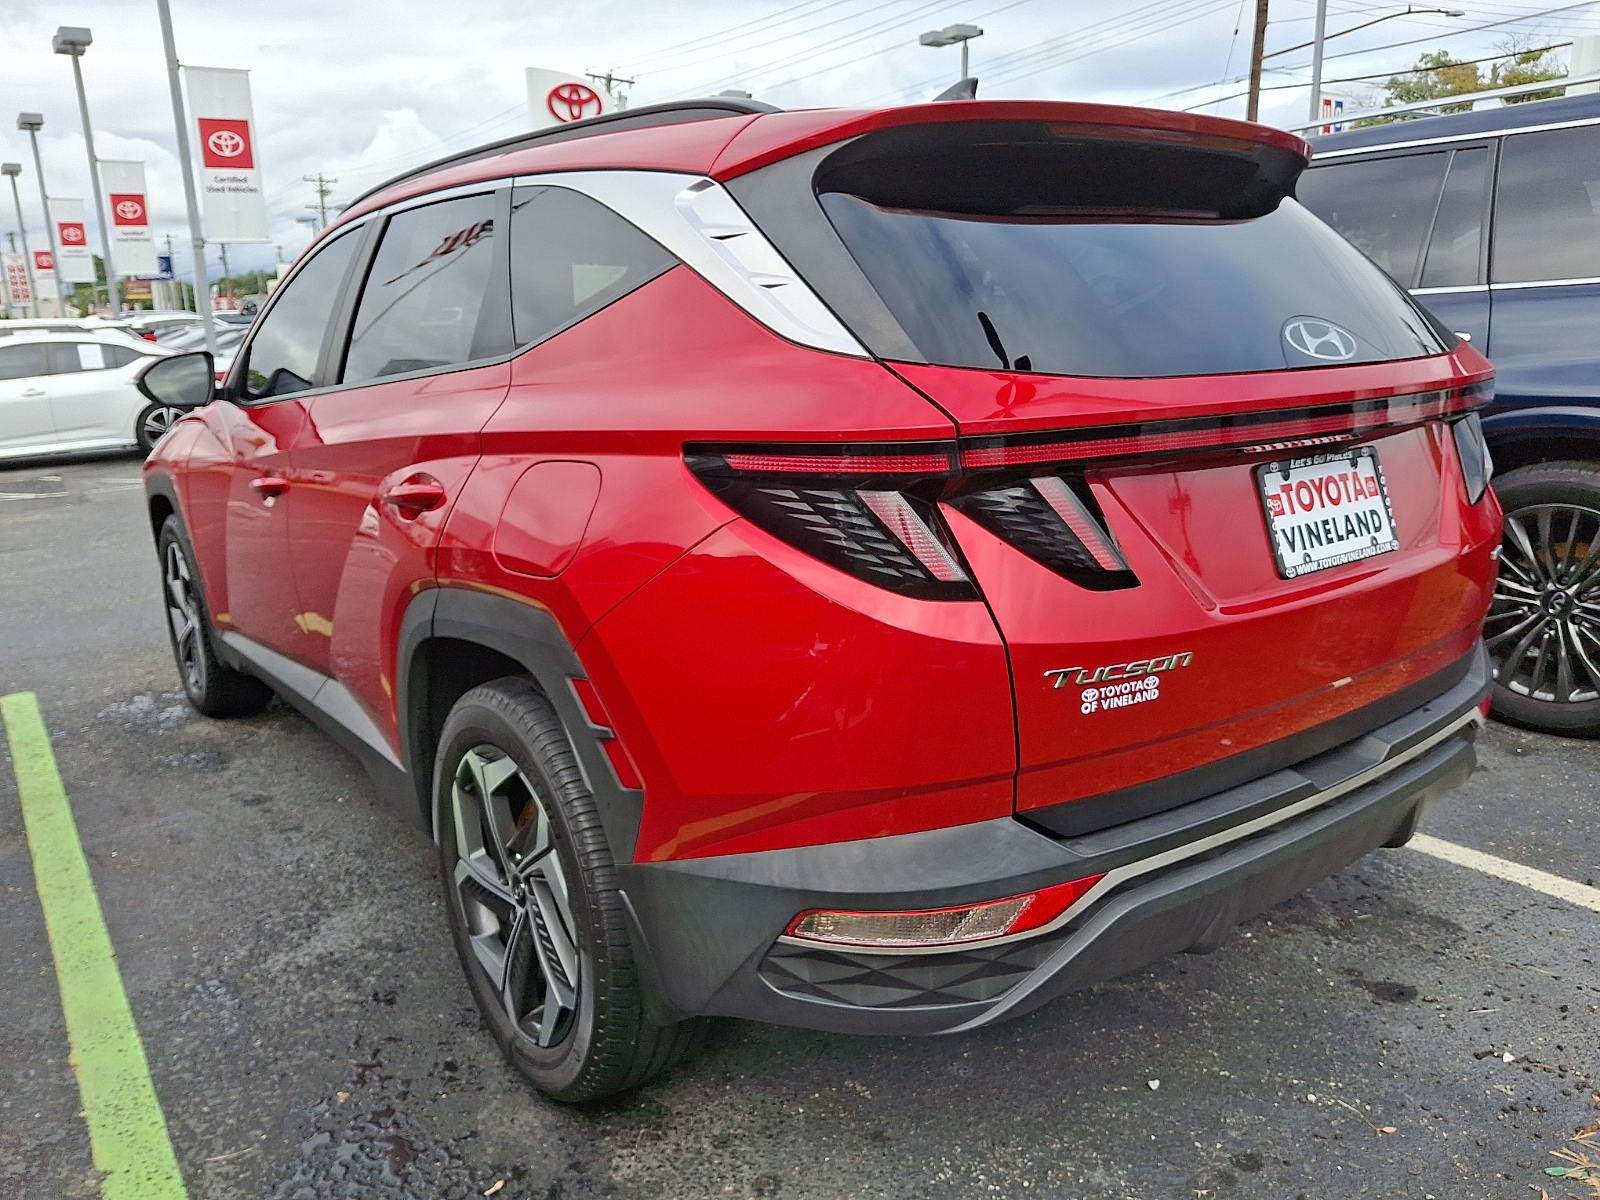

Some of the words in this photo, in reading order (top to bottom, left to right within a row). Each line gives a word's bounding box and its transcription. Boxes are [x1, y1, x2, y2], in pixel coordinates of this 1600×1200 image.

[1313, 455, 1326, 464] Go
[1280, 471, 1367, 515] TOYOTA
[1378, 465, 1396, 528] TOYOTA
[1280, 509, 1382, 554] VINELAND
[1081, 701, 1098, 714] OF
[1101, 689, 1159, 710] VINELAND
[1099, 680, 1144, 698] TOYOTA
